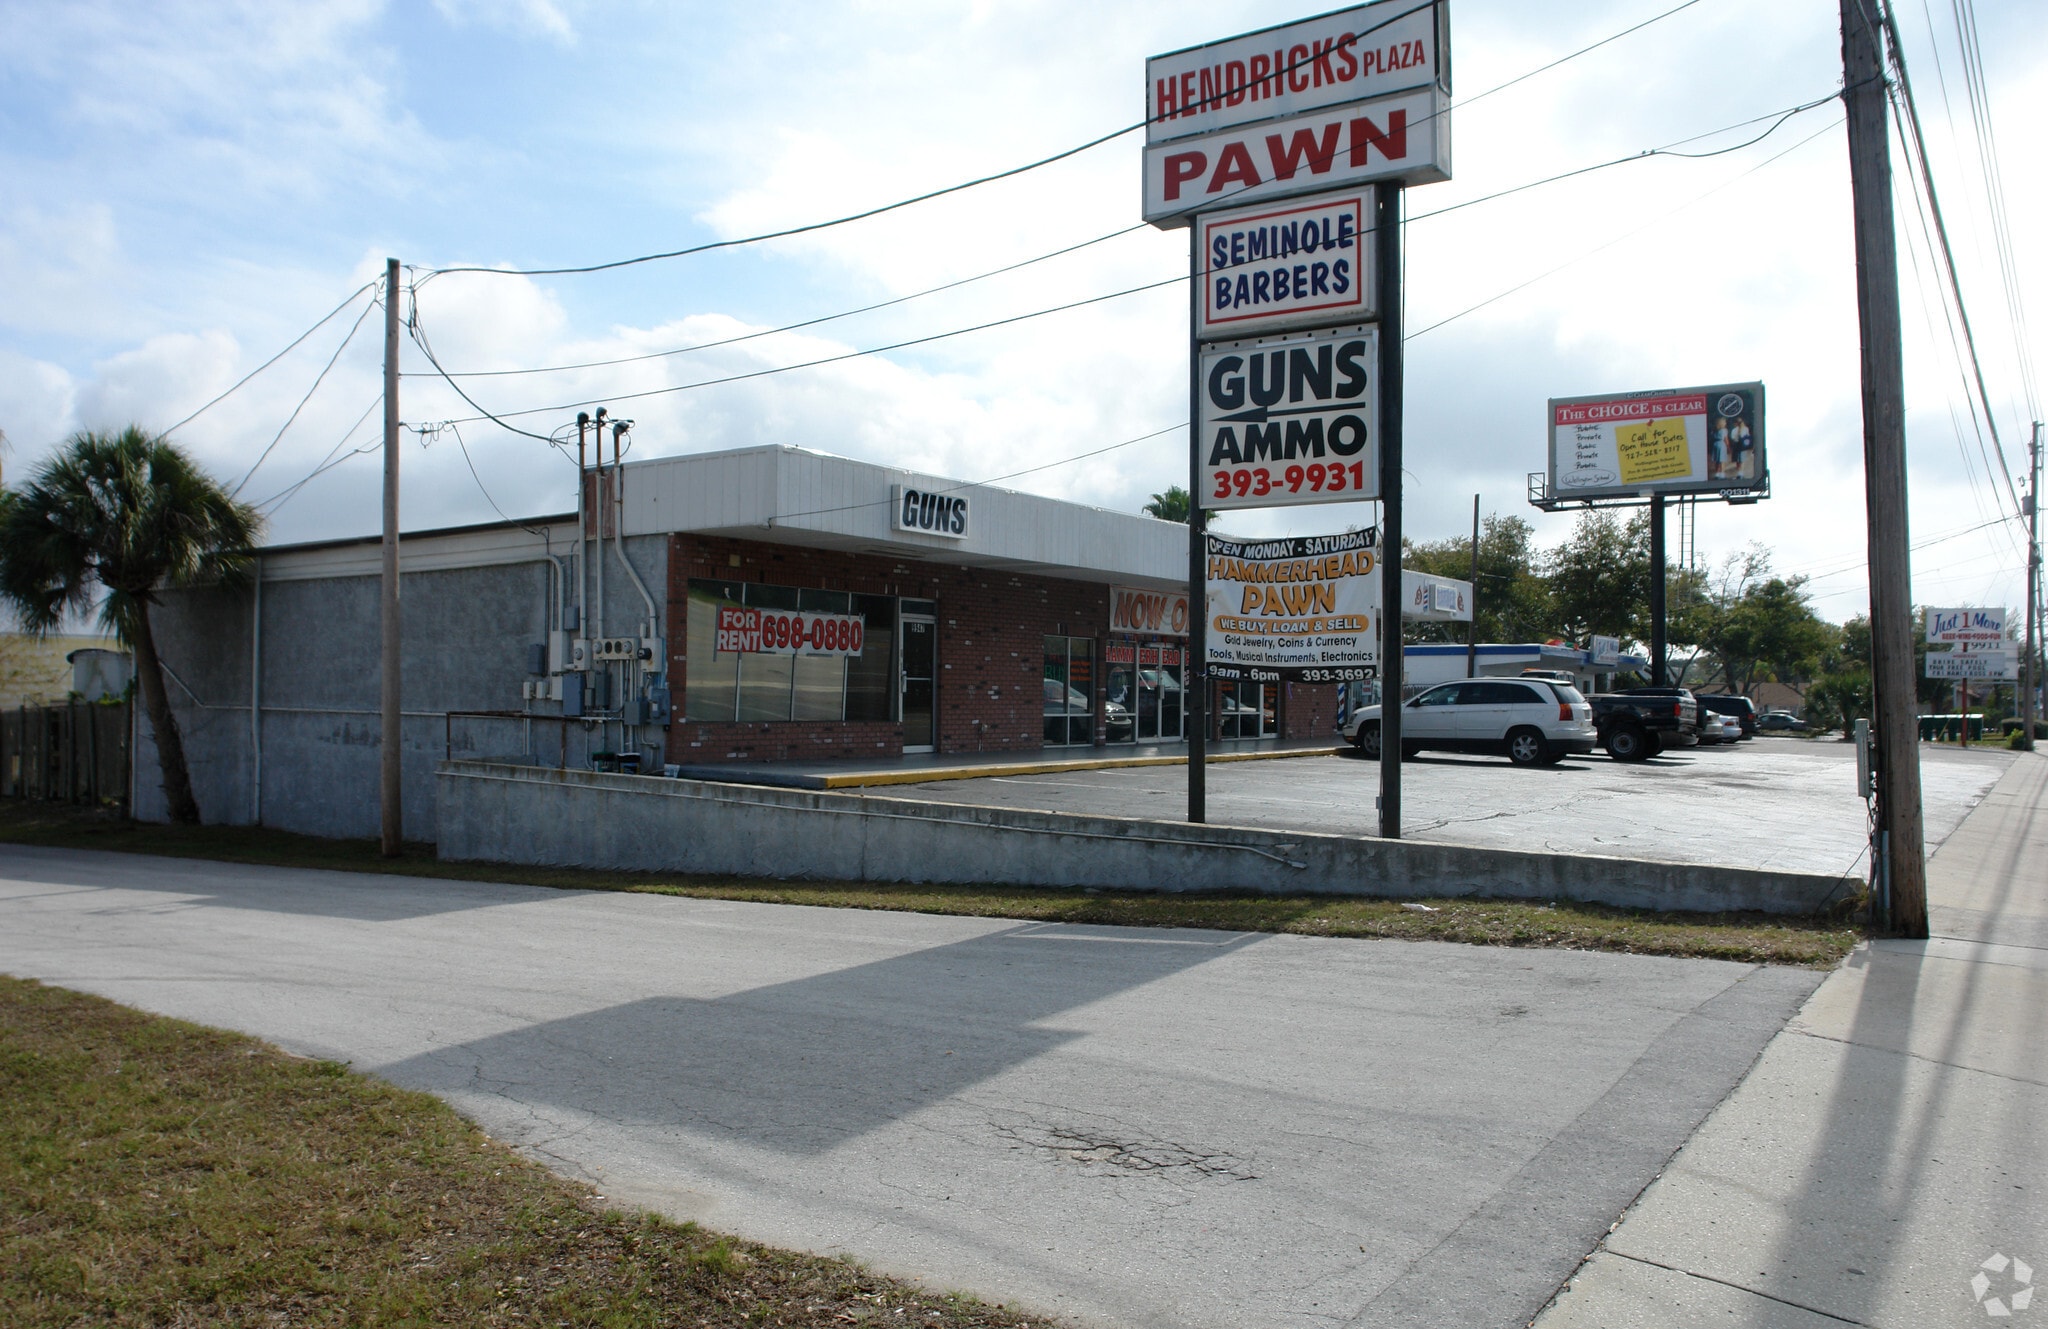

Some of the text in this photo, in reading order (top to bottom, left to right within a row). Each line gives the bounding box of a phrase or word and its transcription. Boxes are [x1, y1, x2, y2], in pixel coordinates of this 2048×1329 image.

[1157, 32, 1426, 123] HENDRICKS PLAZA
[1164, 109, 1407, 201] PAWN
[1212, 213, 1354, 269] SEMINOLE
[1216, 259, 1350, 310] BARBERS
[1208, 340, 1367, 410] GUNS
[1559, 401, 1703, 421] THE CHOICE IS CLEAR
[1208, 414, 1367, 466] AMMO
[1620, 444, 1637, 452] Open
[1631, 429, 1667, 442] Call for
[1213, 460, 1363, 498] 393-9931
[903, 490, 967, 534] GUNS
[1209, 538, 1240, 556] OPEN
[1244, 541, 1295, 559] MONDAY
[1305, 529, 1374, 555] SATURDAY
[1208, 551, 1374, 583] HAMMERHEAD
[1114, 592, 1168, 630] NOW
[1241, 583, 1336, 616] PAWN
[722, 611, 756, 628] FOR
[763, 615, 862, 651] 698-0880
[1220, 618, 1361, 635] WE BUY, LOAN & SELL
[1931, 612, 2001, 636] Just 1 More
[717, 630, 760, 651] RENT
[1209, 649, 1373, 664] Tools, Musical Instruments, Electronics
[1225, 635, 1357, 649] Gold Jewelry, Coins & Currency
[1209, 665, 1240, 678] 9am
[1251, 669, 1280, 681] 6pm
[1302, 669, 1373, 681] 393-3692
